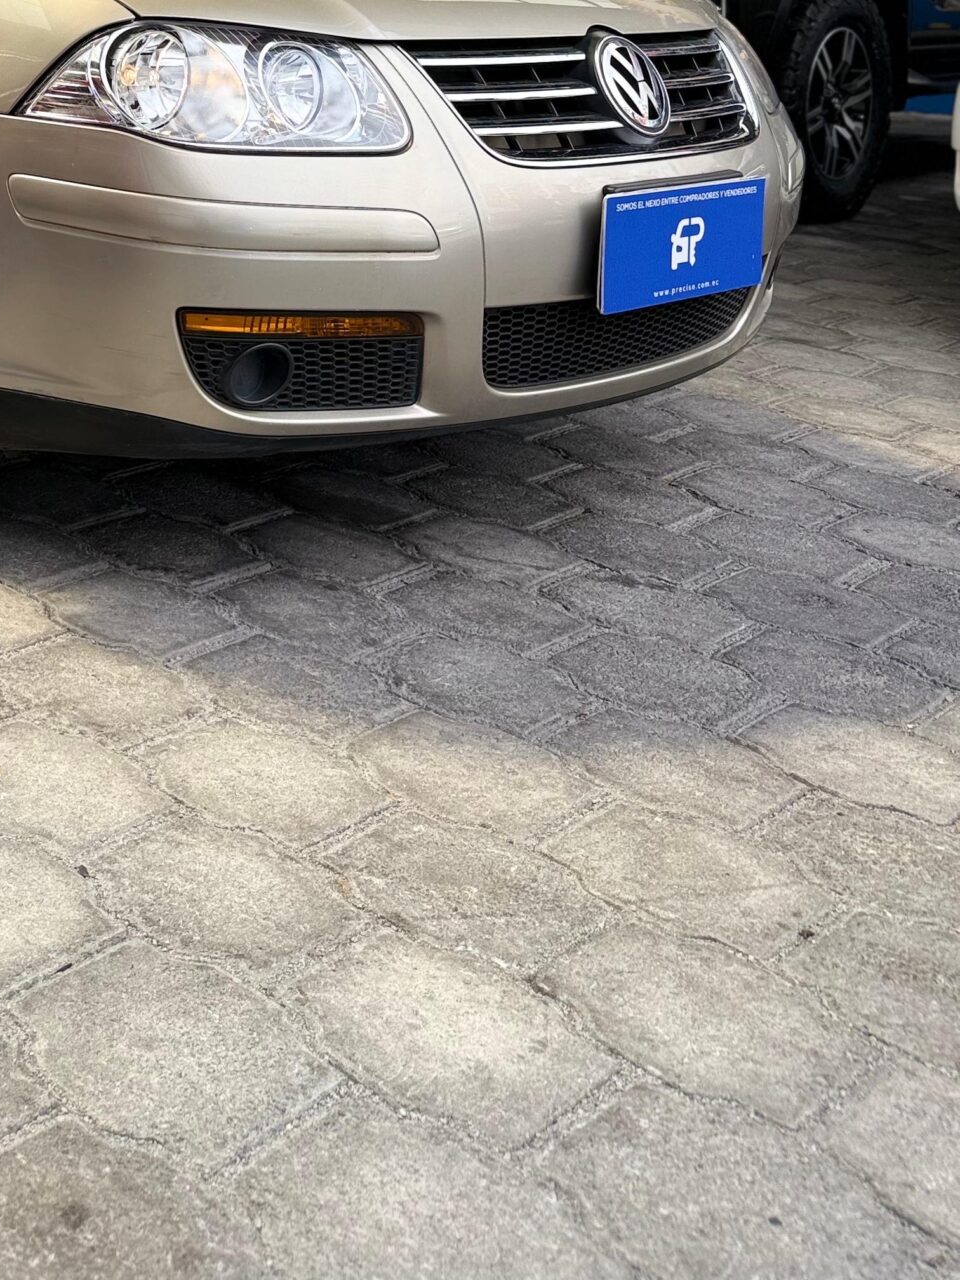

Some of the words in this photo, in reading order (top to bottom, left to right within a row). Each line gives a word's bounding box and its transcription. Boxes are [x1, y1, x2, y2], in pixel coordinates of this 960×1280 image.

[616, 202, 638, 212] SOMOS
[645, 198, 660, 208] NEXO
[661, 196, 679, 206] ENTRE
[679, 191, 719, 204] COMPRADORES
[724, 186, 757, 197] VENDEDORES
[653, 280, 720, 298] www.preciso.com.ec
